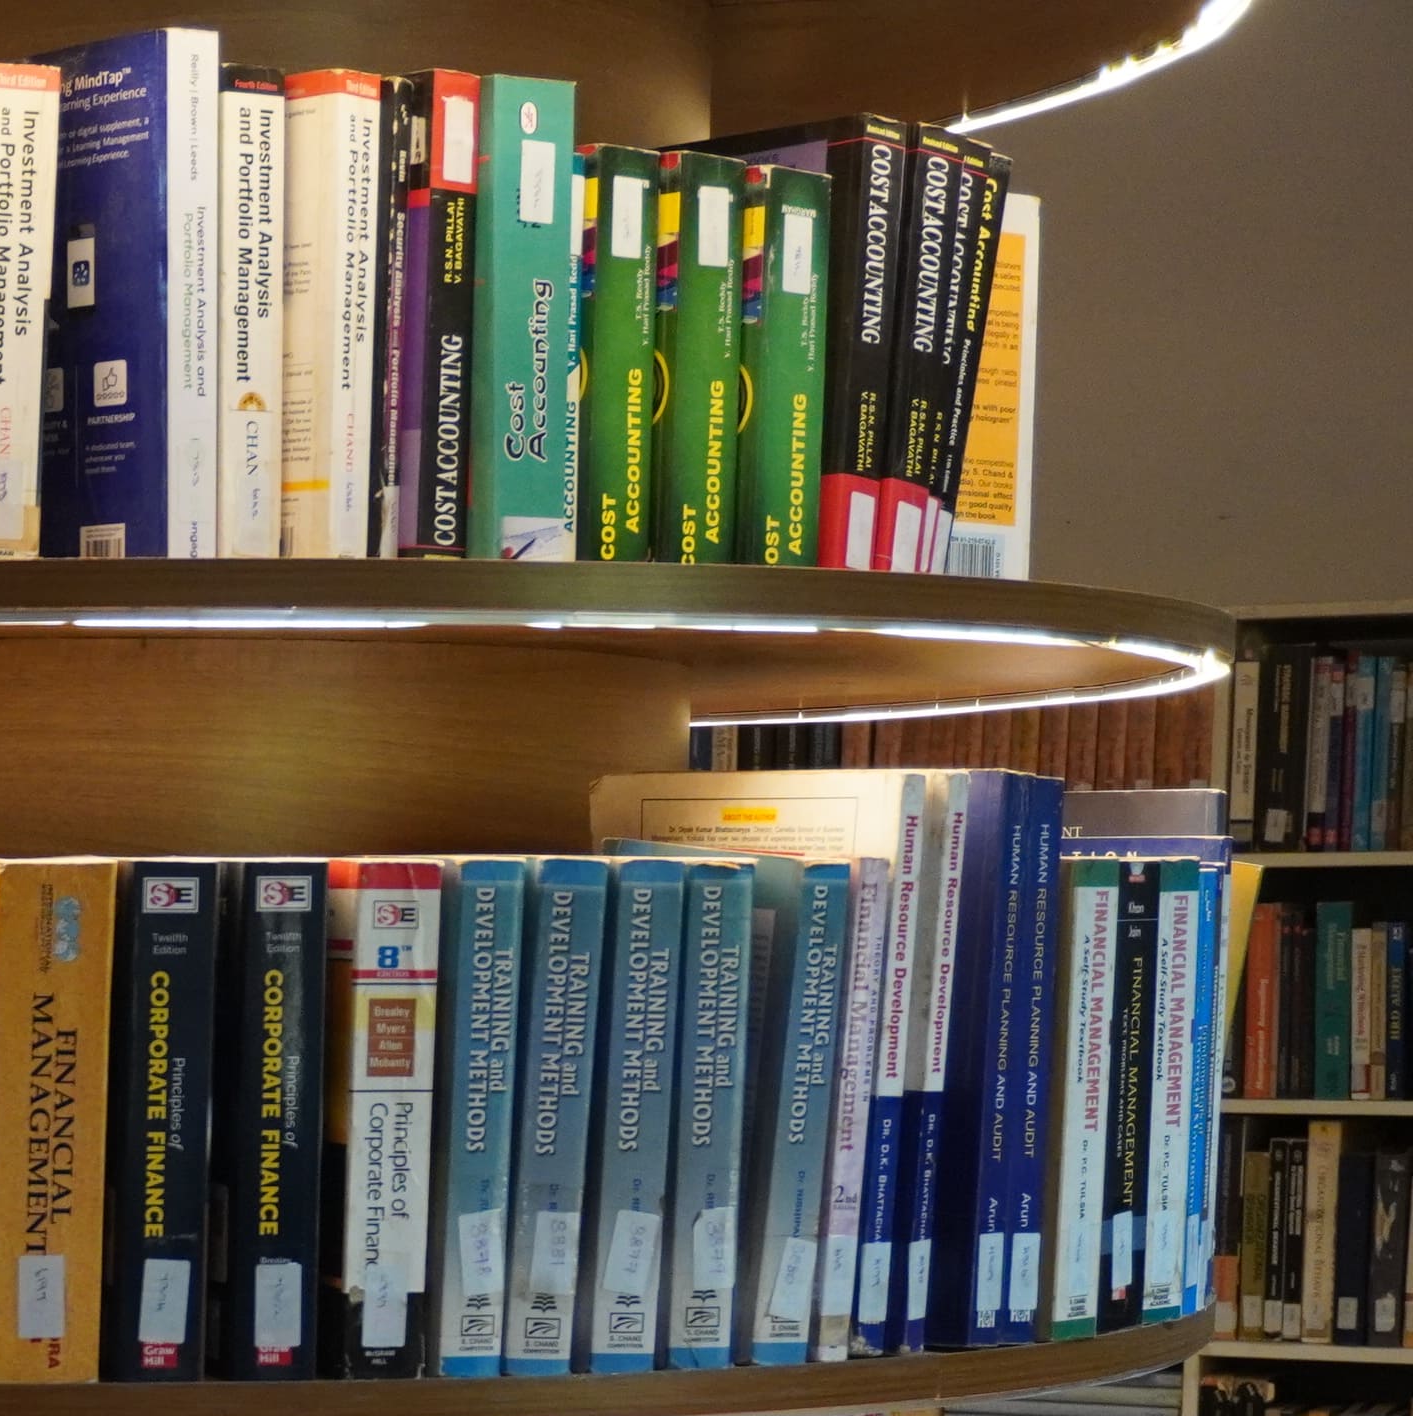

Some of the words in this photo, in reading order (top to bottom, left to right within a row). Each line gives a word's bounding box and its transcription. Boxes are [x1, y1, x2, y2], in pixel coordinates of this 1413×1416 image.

[21, 76, 46, 88] Edition
[189, 54, 199, 86] Reilly
[0, 107, 10, 136] and
[190, 98, 198, 133] Brown
[19, 110, 39, 234] Investment
[444, 202, 455, 245] PILLAI
[454, 197, 465, 270] BAGAVATHI
[14, 242, 36, 336] Analysis
[443, 248, 454, 284] R.S.N.
[439, 334, 463, 474] ACCOUNTING
[527, 279, 555, 462] Accounting
[504, 381, 526, 462] Cost
[434, 476, 456, 547] COST
[905, 815, 918, 875] Human
[895, 882, 914, 961] Resource
[469, 888, 495, 1046] DEVELOPMENT
[492, 948, 514, 1052] TRAINING
[147, 971, 170, 1120] CORPORATE
[375, 1007, 410, 1018] Brealey
[377, 1023, 406, 1034] Myers
[379, 1040, 403, 1051] Allen
[886, 968, 906, 1078] Development
[172, 1058, 186, 1125] Principles
[369, 1056, 411, 1069] Mohanty
[488, 1058, 505, 1091] and
[465, 1050, 488, 1152] METHODS
[172, 1129, 183, 1150] of
[145, 1132, 166, 1238] FINANCE
